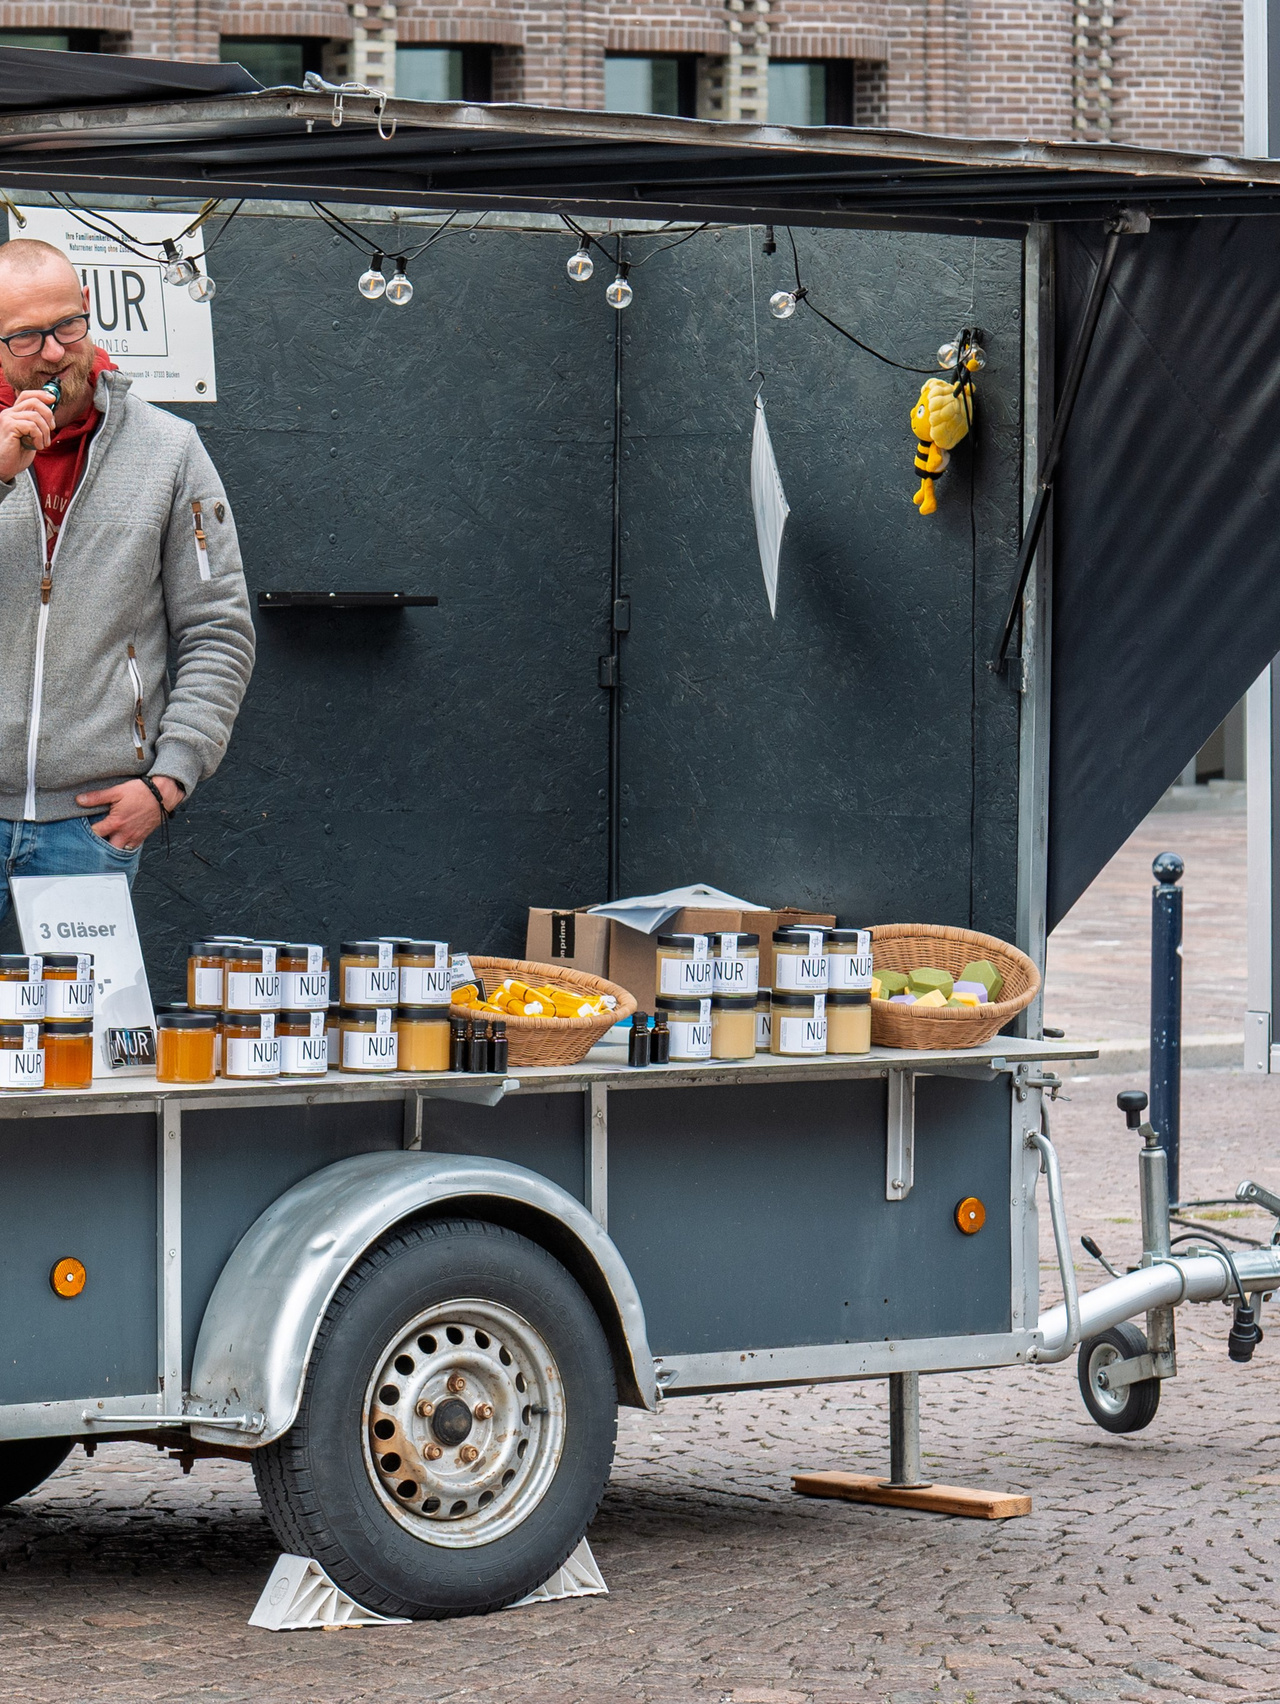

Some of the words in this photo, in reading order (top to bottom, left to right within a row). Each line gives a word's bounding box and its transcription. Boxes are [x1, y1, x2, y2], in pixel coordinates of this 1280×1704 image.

[39, 922, 52, 939] 3
[56, 921, 117, 939] Gläser
[559, 920, 567, 949] prime
[713, 961, 744, 981] NUR
[801, 958, 826, 978] NUR
[255, 976, 280, 997] NUR
[300, 976, 326, 996] NUR
[371, 971, 396, 991] NUR
[115, 1031, 150, 1056] NUR
[253, 1042, 278, 1063] NUR
[303, 1040, 327, 1060] NUR
[368, 1037, 395, 1056] NUR
[15, 1053, 42, 1074] NUR
